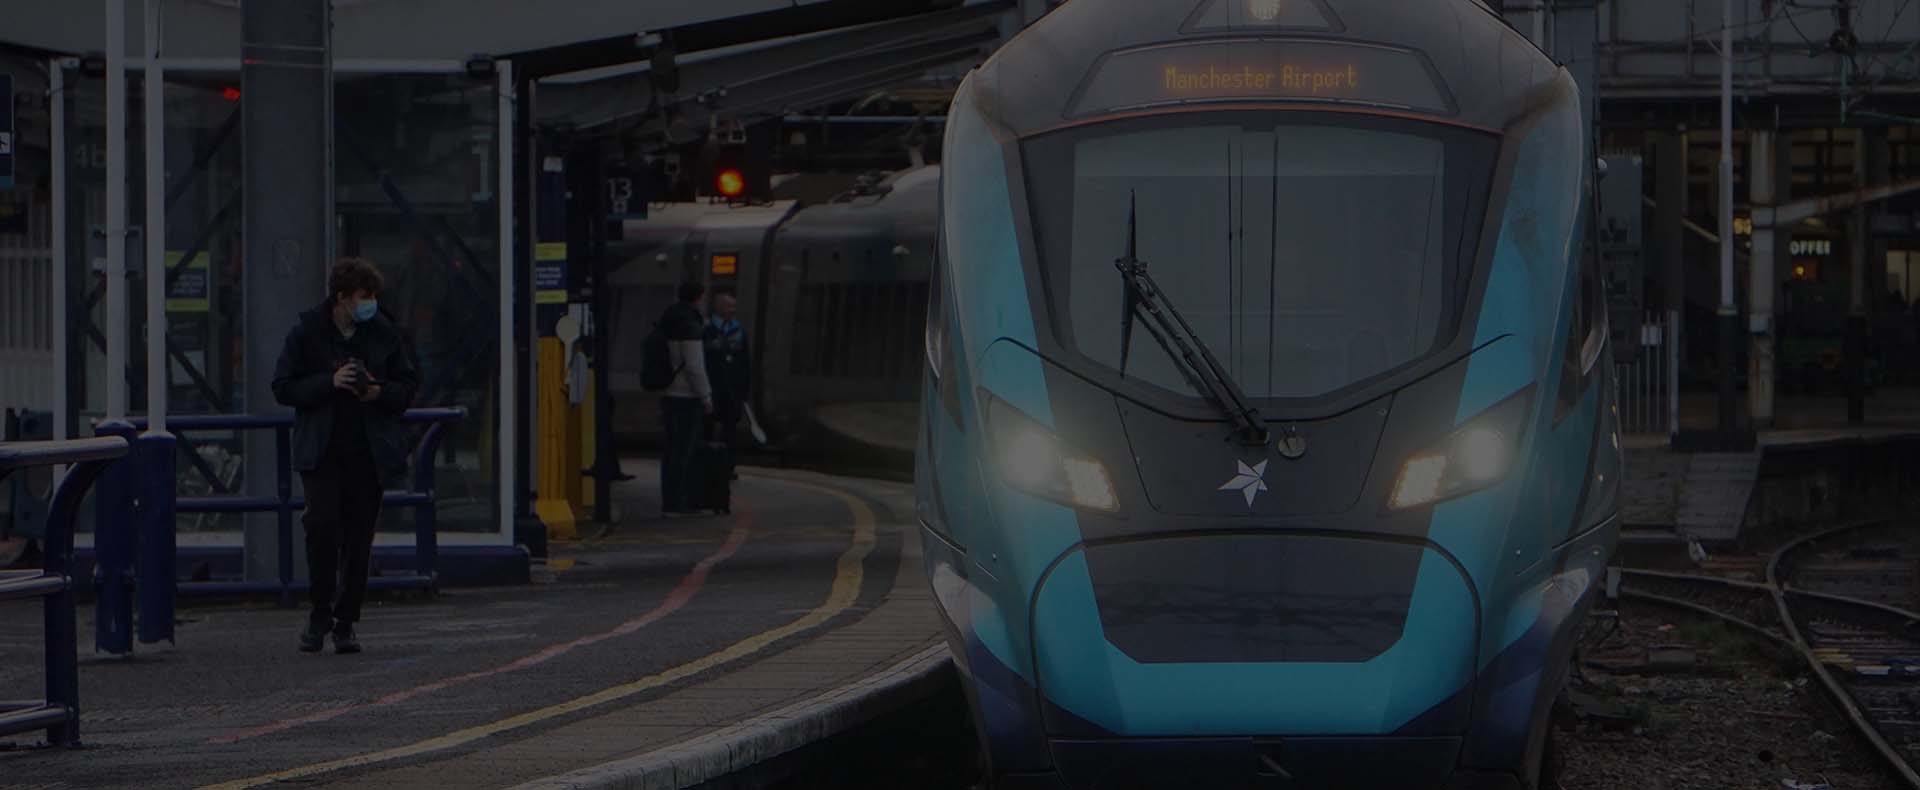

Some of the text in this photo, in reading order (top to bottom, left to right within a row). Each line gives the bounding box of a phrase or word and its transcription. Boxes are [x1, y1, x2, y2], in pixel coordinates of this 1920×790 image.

[1165, 64, 1357, 93] Manchester Airport
[607, 177, 633, 200] 13
[1788, 239, 1832, 257] OFFEE
